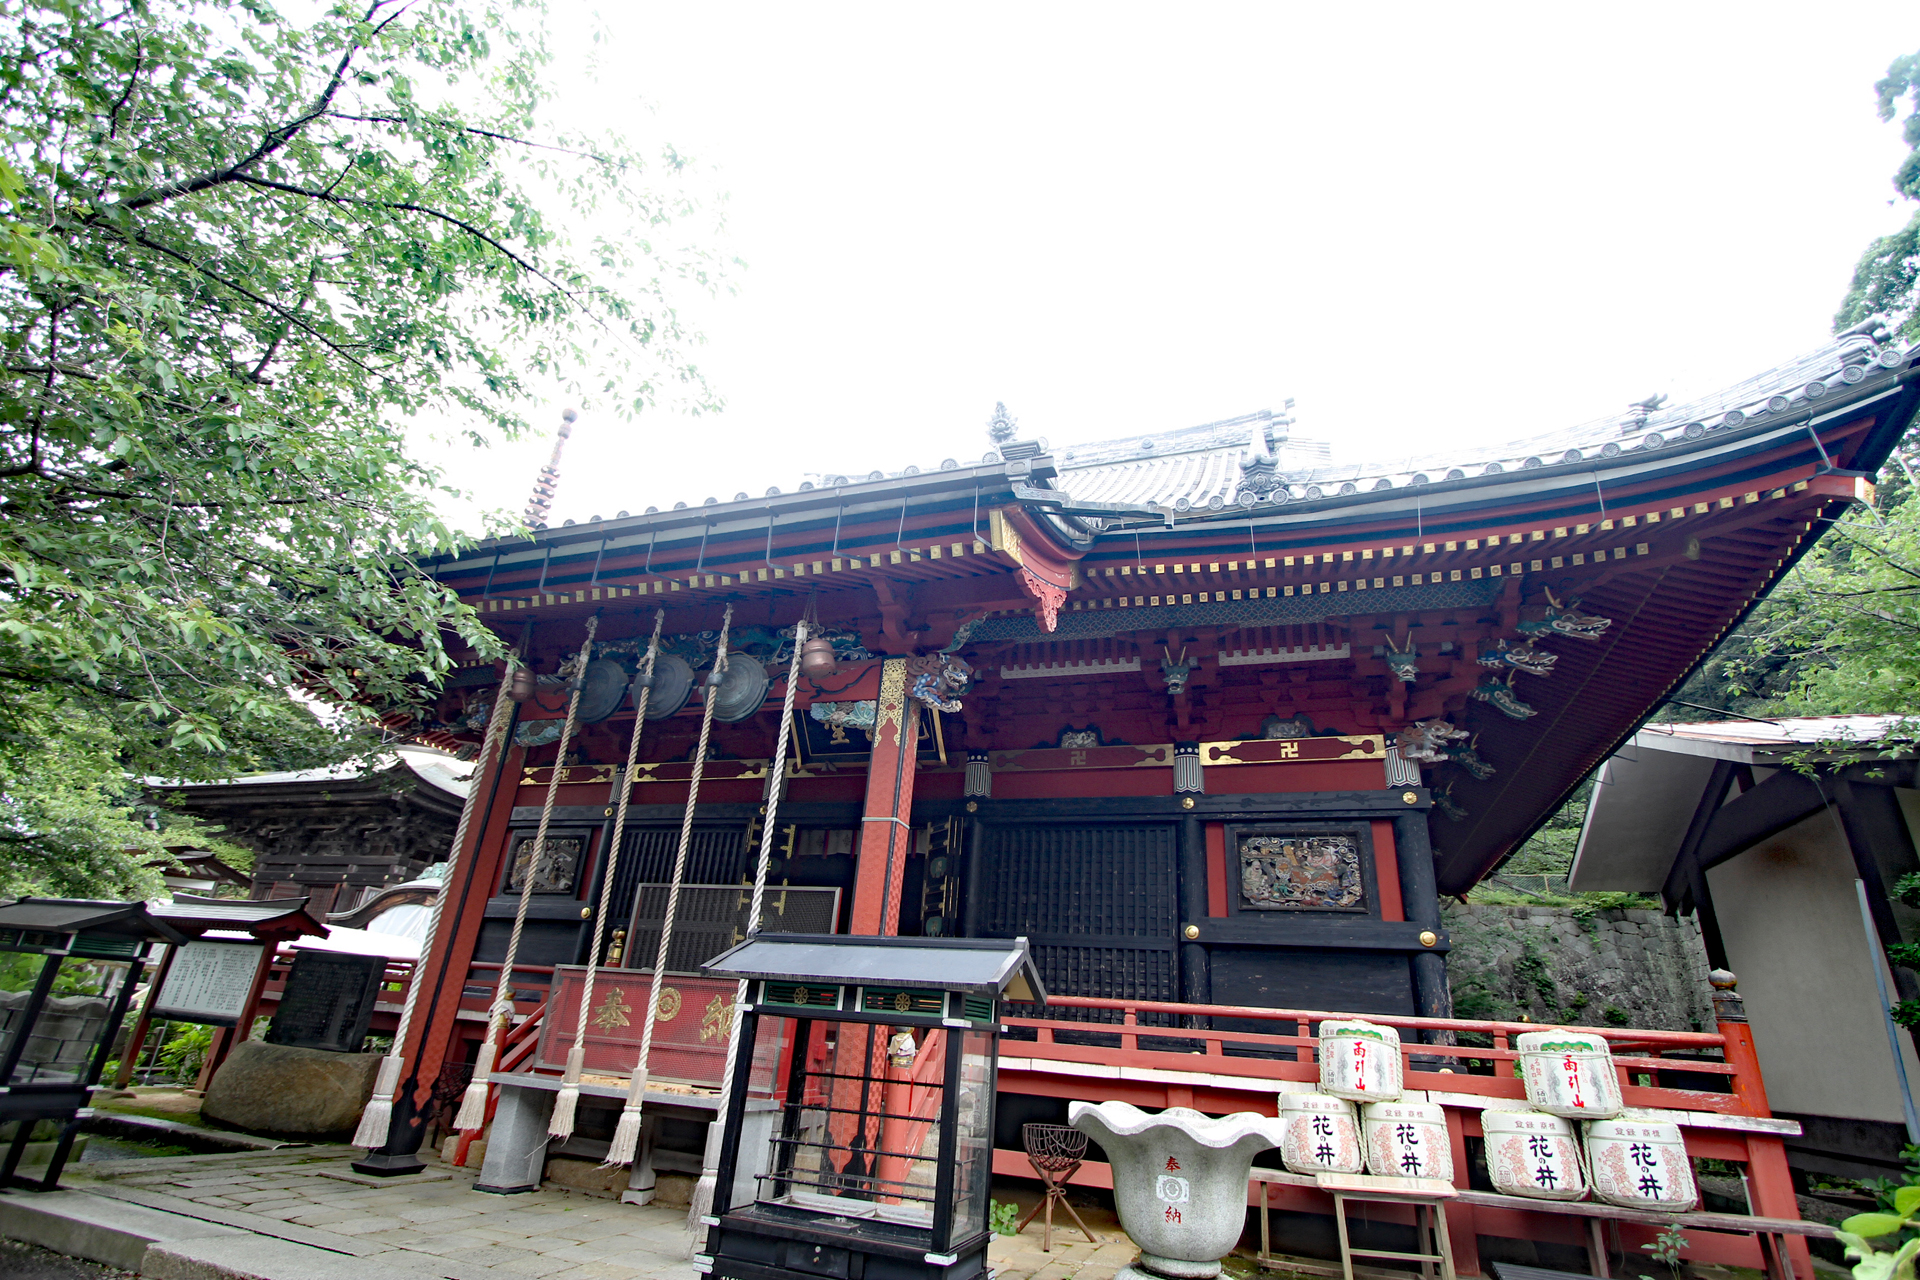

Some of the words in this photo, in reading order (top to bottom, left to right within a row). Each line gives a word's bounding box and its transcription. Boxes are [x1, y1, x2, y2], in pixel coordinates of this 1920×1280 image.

[590, 987, 632, 1036] 奉
[1353, 1041, 1366, 1091] 雨引山
[1562, 1055, 1585, 1108] 雨引山
[1165, 1156, 1181, 1173] 奉
[1312, 1115, 1335, 1166] 花の井
[1396, 1123, 1422, 1176] 花の井
[1528, 1135, 1558, 1190] 花の井
[1629, 1143, 1663, 1200] 花の井
[1165, 1205, 1181, 1224] 納
